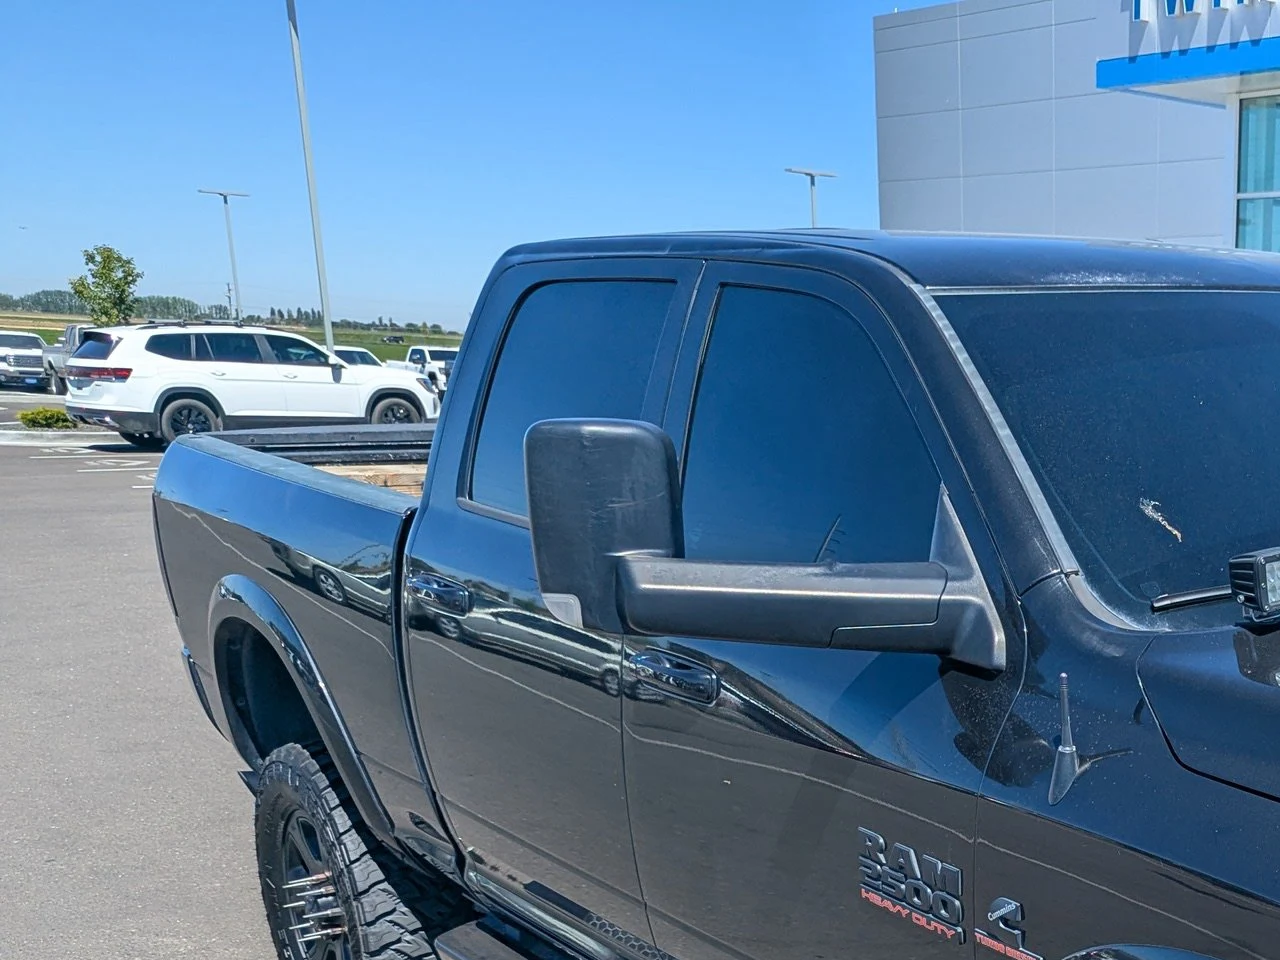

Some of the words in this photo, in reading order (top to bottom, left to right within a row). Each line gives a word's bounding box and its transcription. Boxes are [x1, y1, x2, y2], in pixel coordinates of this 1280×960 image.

[858, 826, 964, 897] RAM
[858, 856, 965, 925] 2500
[860, 888, 910, 918] HEAVY
[911, 913, 956, 939] DUTY
[987, 902, 1017, 921] Cummins
